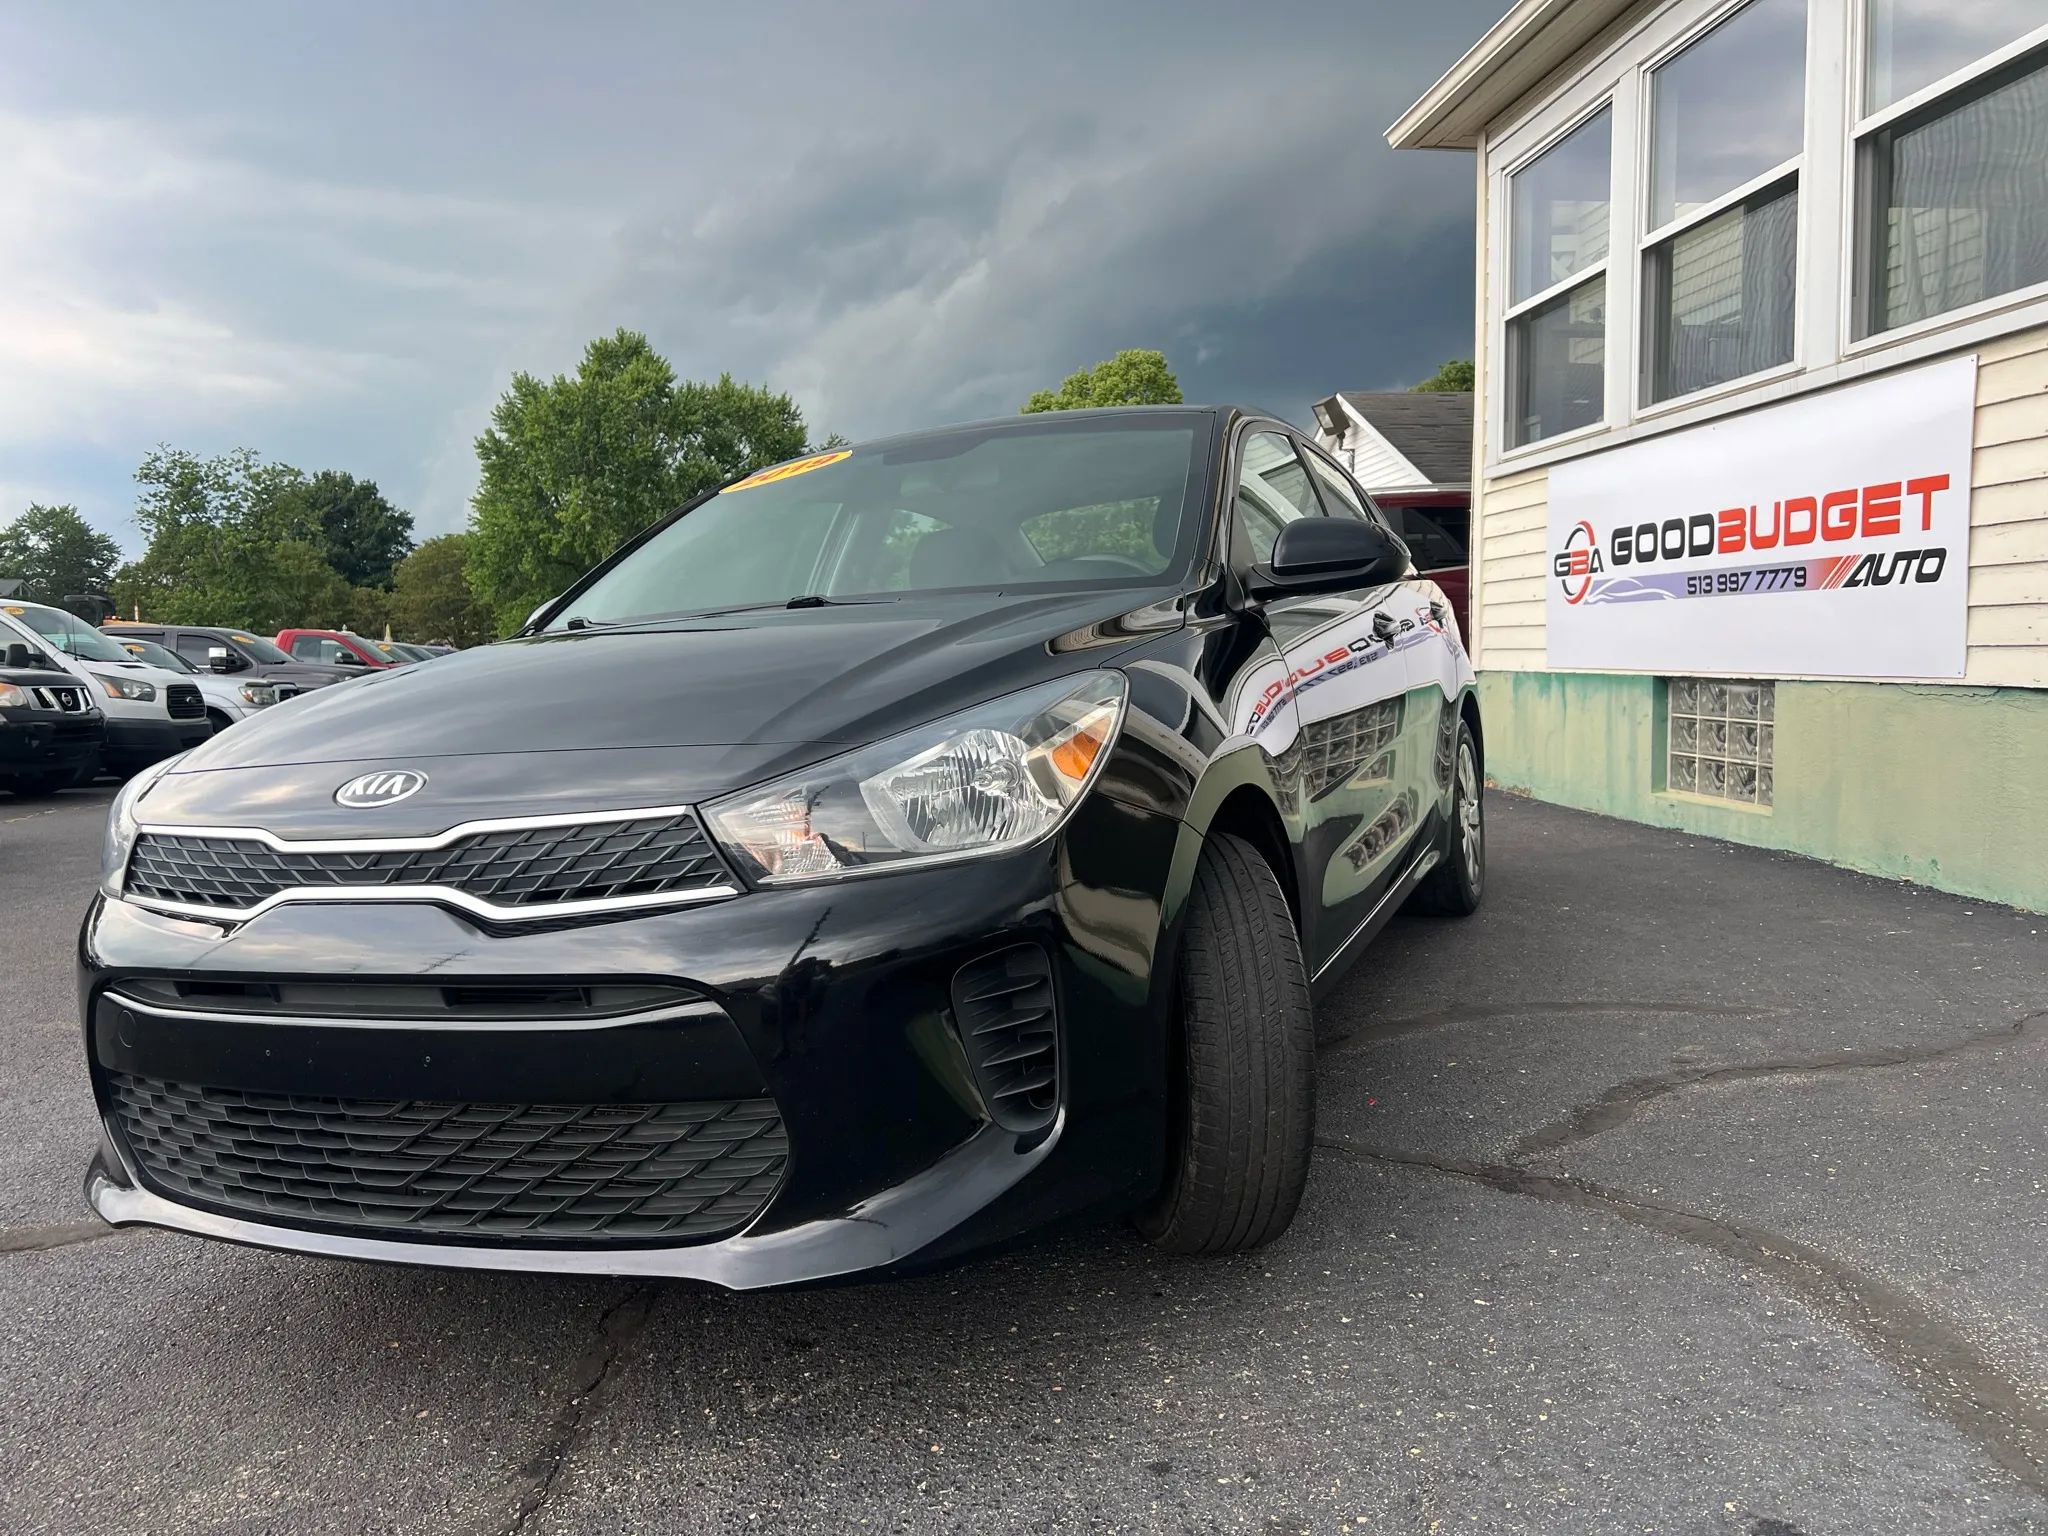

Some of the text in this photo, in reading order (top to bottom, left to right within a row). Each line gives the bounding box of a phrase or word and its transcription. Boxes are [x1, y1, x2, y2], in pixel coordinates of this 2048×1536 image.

[1554, 548, 1604, 577] GBA
[1841, 547, 1947, 588] AUTO
[1687, 566, 1806, 595] 513 997 7779
[344, 774, 407, 797] KIA
